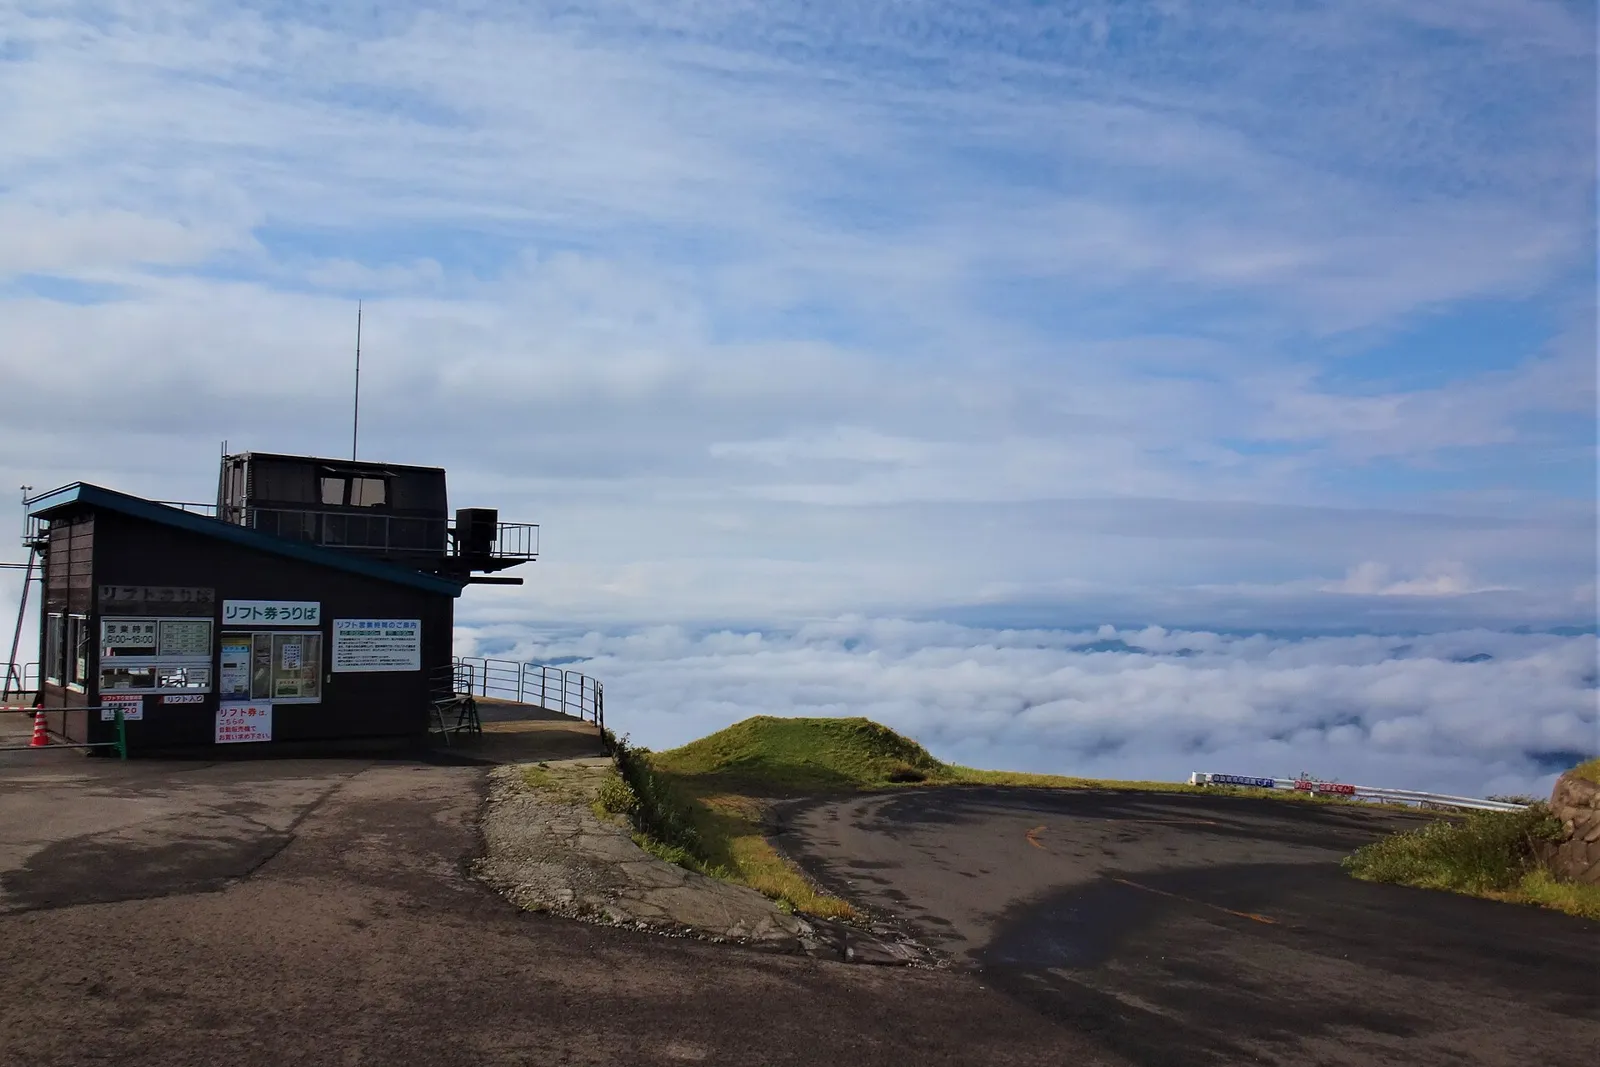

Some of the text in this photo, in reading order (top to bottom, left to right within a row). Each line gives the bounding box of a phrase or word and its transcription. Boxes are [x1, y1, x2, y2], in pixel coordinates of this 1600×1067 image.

[226, 605, 317, 622] リフト券うりば
[107, 625, 154, 634] 営業時間
[219, 725, 257, 733] 自動販売機で
